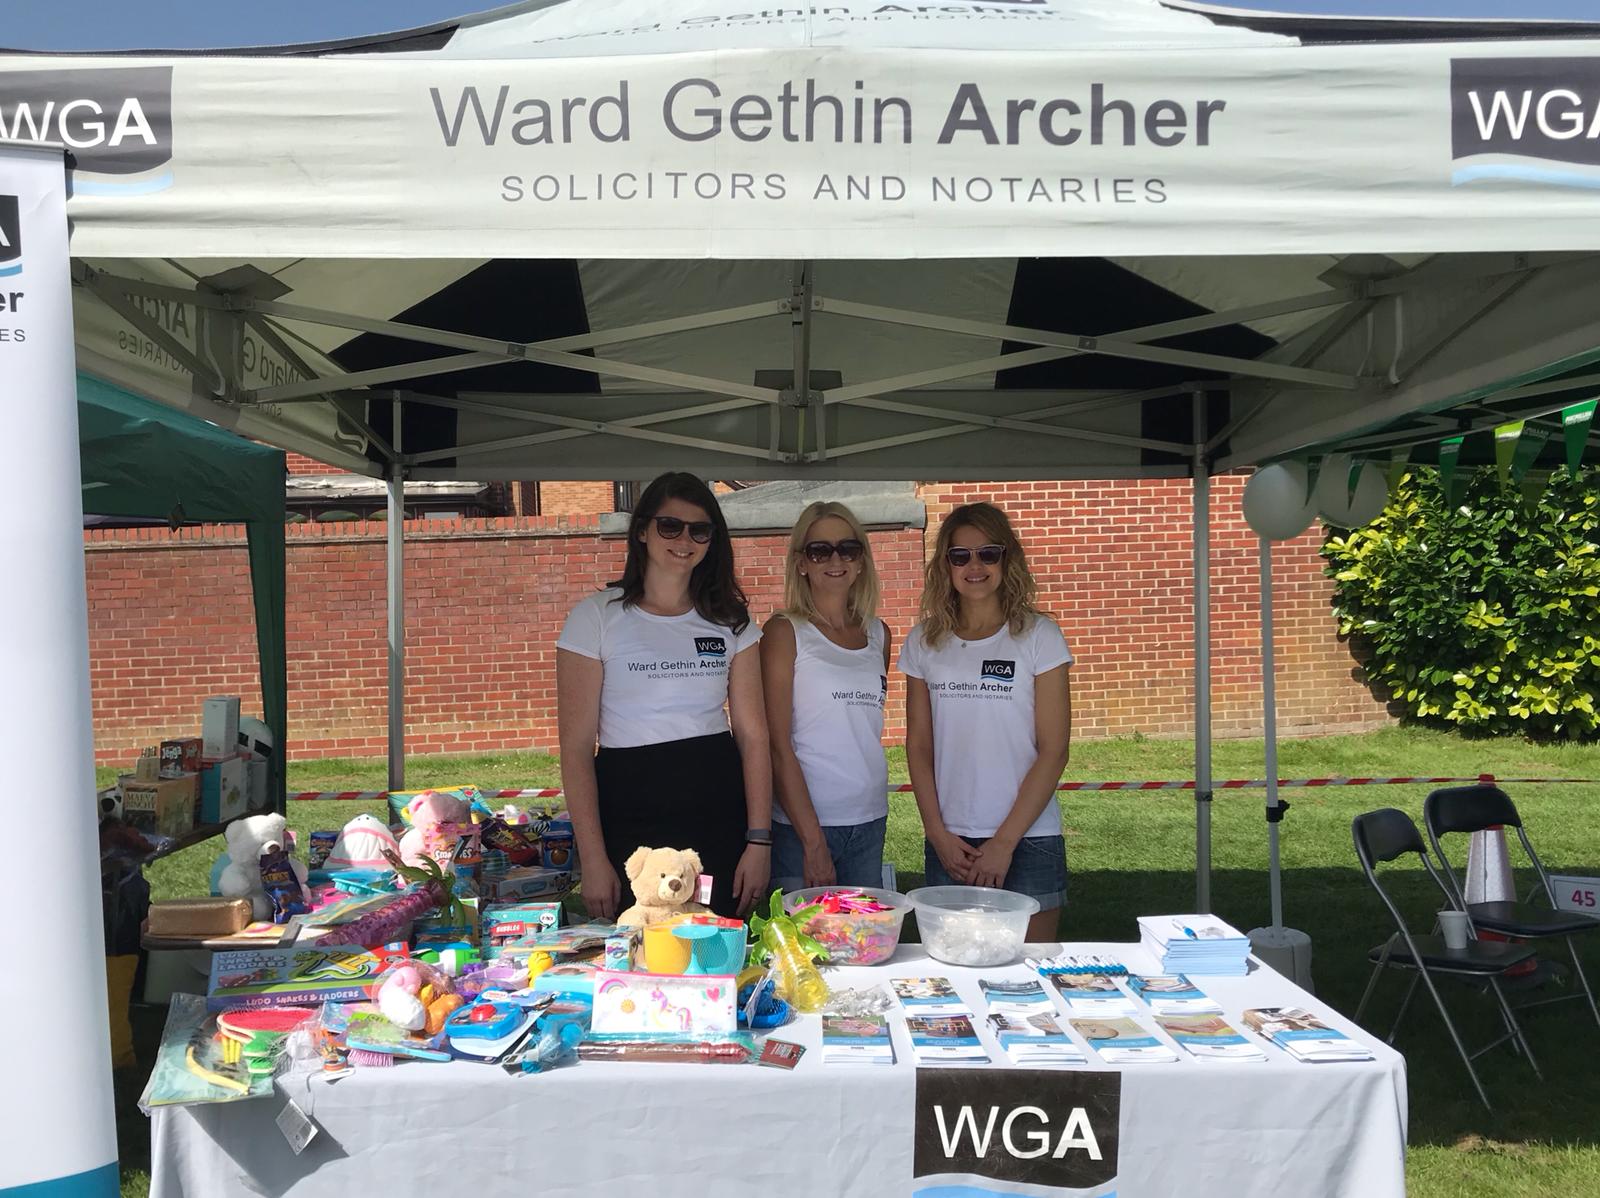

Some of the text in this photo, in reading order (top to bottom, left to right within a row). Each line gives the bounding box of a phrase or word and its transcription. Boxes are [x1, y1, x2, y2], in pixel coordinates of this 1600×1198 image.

[429, 77, 1227, 147] Ward Gethin Archer
[0, 97, 157, 148] WGA
[501, 171, 1168, 203] SOLICITORS AND NOTARIES
[627, 661, 657, 672] Ward
[660, 660, 696, 671] Gethin
[984, 664, 1012, 675] WGA
[831, 691, 854, 700] Ward
[948, 681, 978, 691] Gethin
[980, 682, 1014, 693] Archer
[1571, 889, 1596, 907] 45
[246, 998, 271, 1006] LUDO
[276, 994, 308, 1004] SNAKES
[319, 990, 360, 1001] LADDERS
[933, 1105, 1103, 1160] WGA
